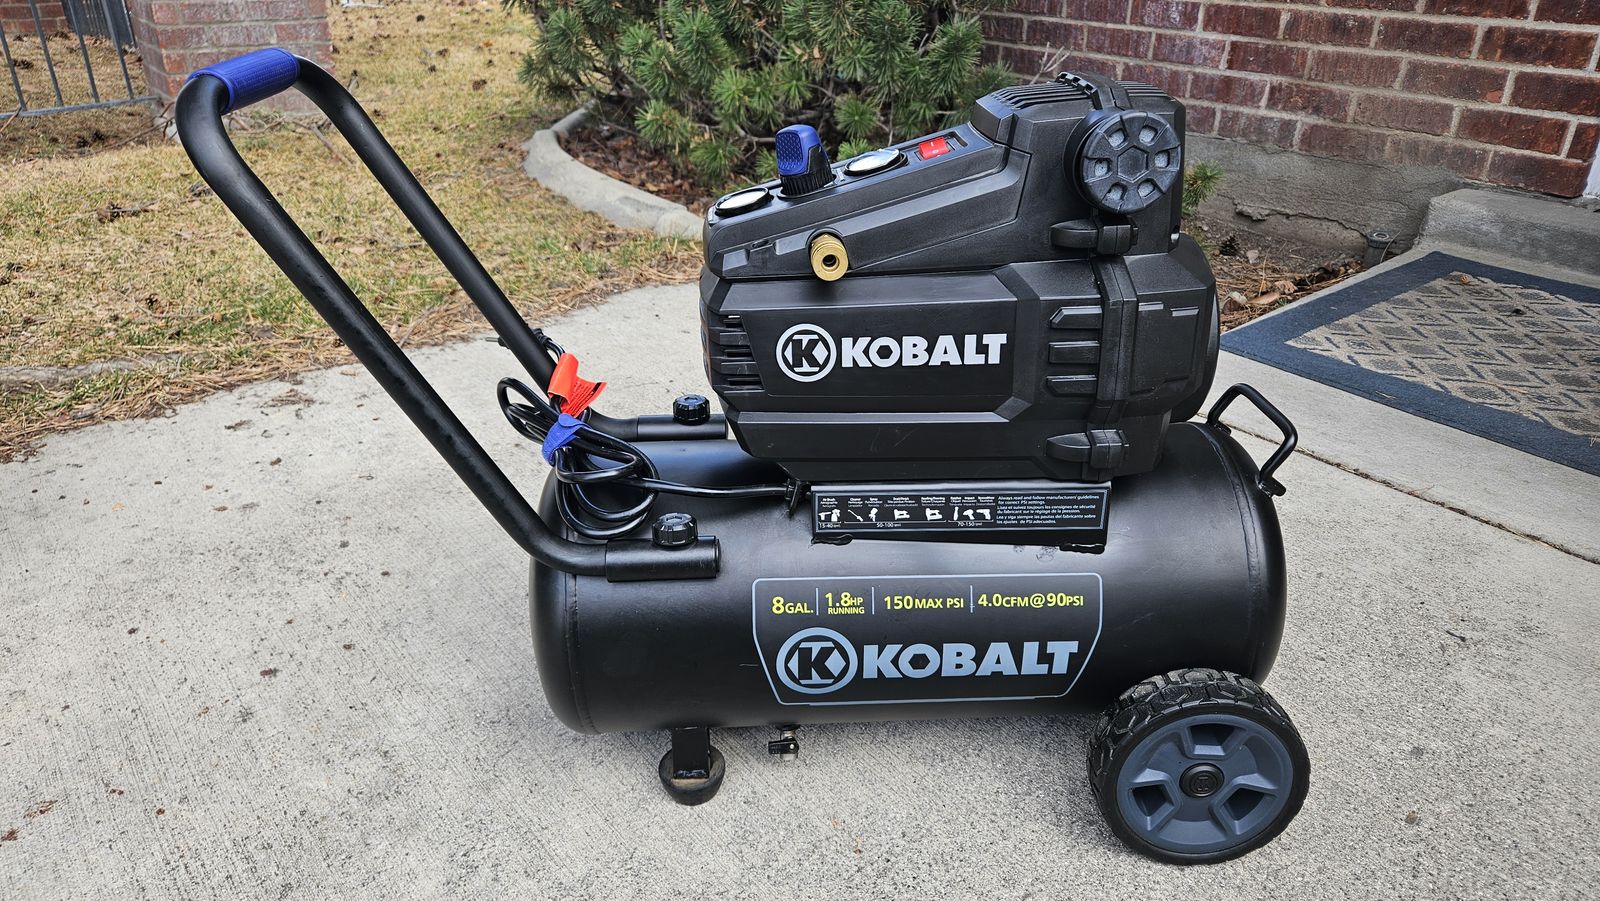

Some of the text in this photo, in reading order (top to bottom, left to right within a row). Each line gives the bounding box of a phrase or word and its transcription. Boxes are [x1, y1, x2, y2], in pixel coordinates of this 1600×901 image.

[841, 333, 1007, 368] KOBALT
[828, 606, 865, 615] RUNNING
[946, 597, 964, 608] PSI
[862, 640, 1079, 679] KOBALT
